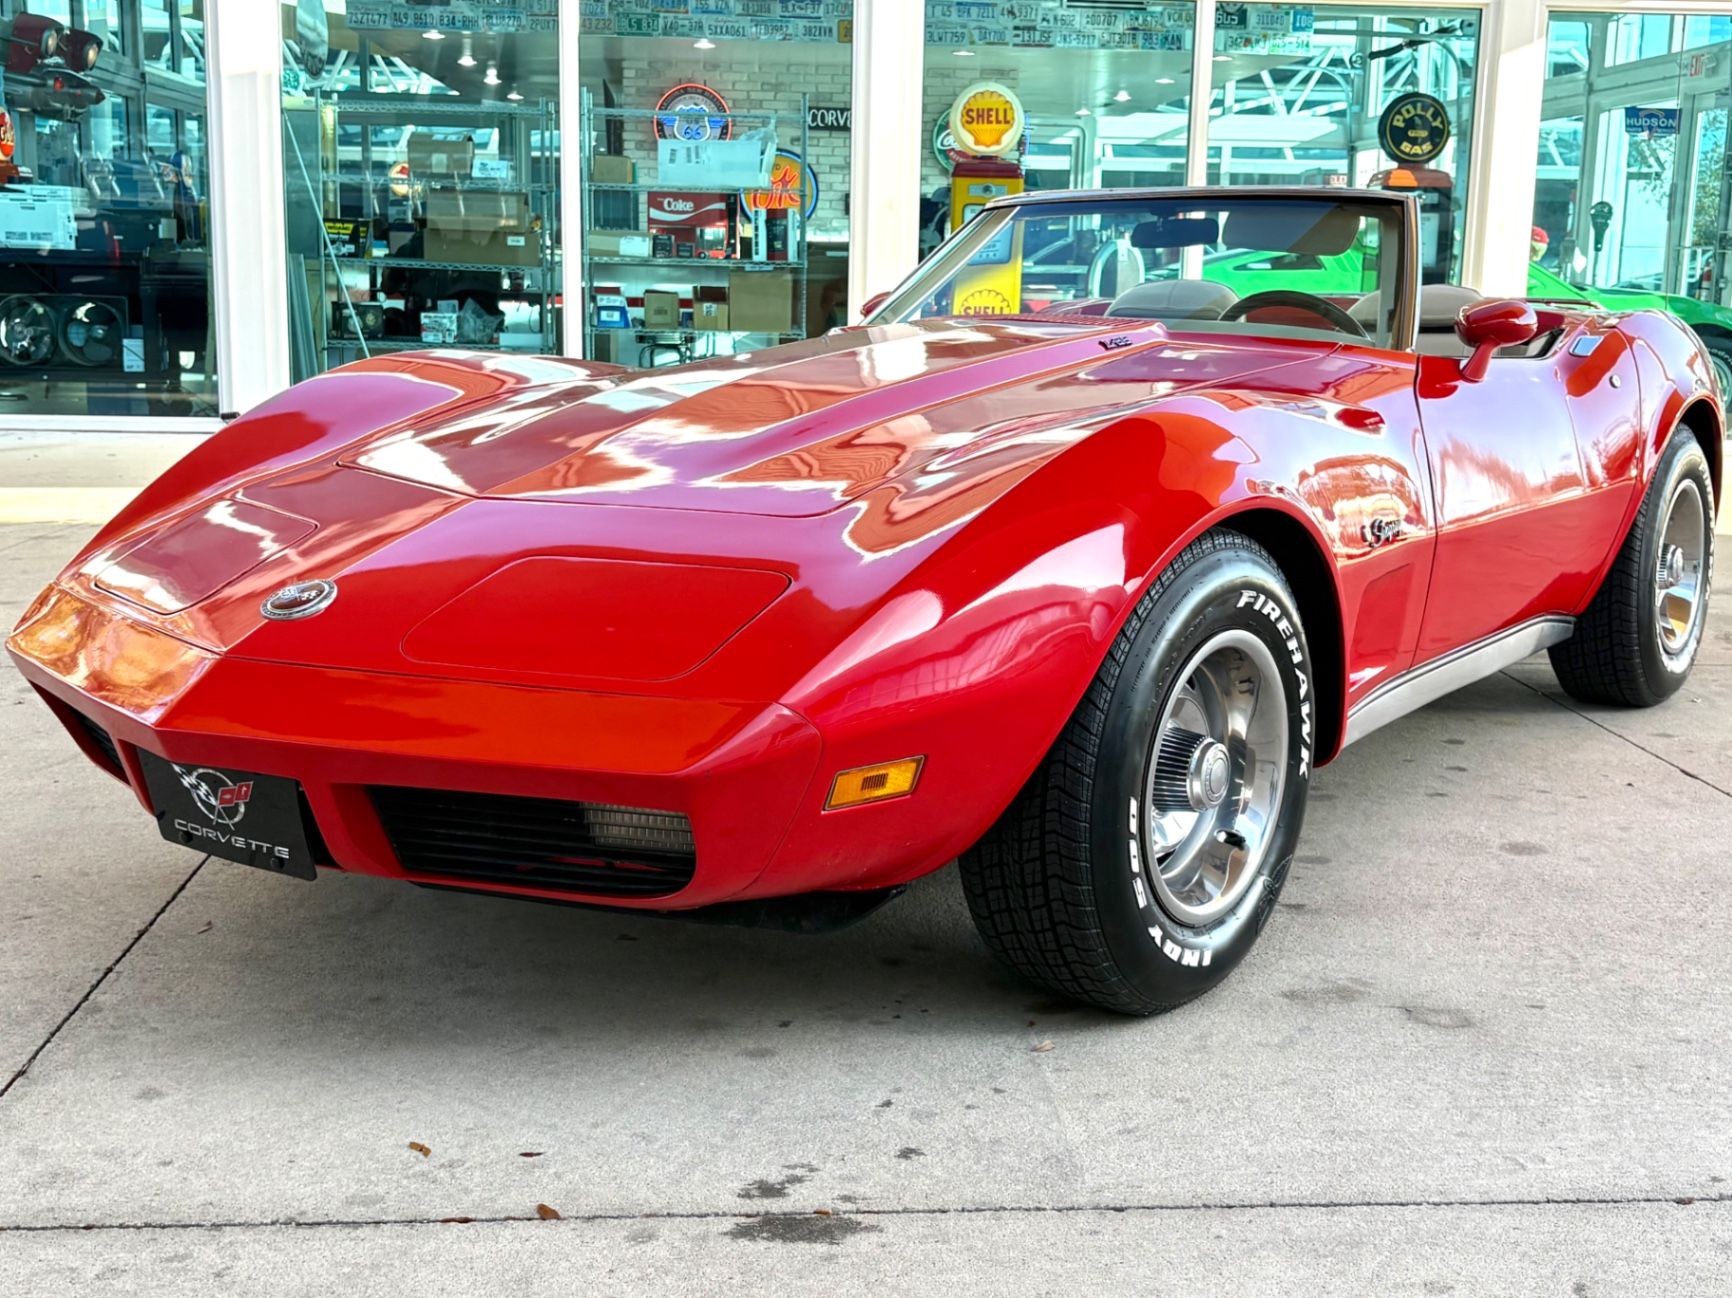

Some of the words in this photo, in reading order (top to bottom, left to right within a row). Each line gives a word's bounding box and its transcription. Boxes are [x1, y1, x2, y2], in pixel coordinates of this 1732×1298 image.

[964, 107, 1011, 125] SHELL
[1392, 102, 1444, 129] POLLY
[1625, 117, 1677, 127] HUDSON
[683, 125, 704, 140] 66
[1399, 141, 1433, 155] GAS
[663, 197, 694, 211] Coke
[1235, 589, 1312, 780] FIREHAWK
[174, 818, 290, 860] CORVETTE
[1128, 796, 1149, 909] 500
[1147, 924, 1213, 968] INDY
